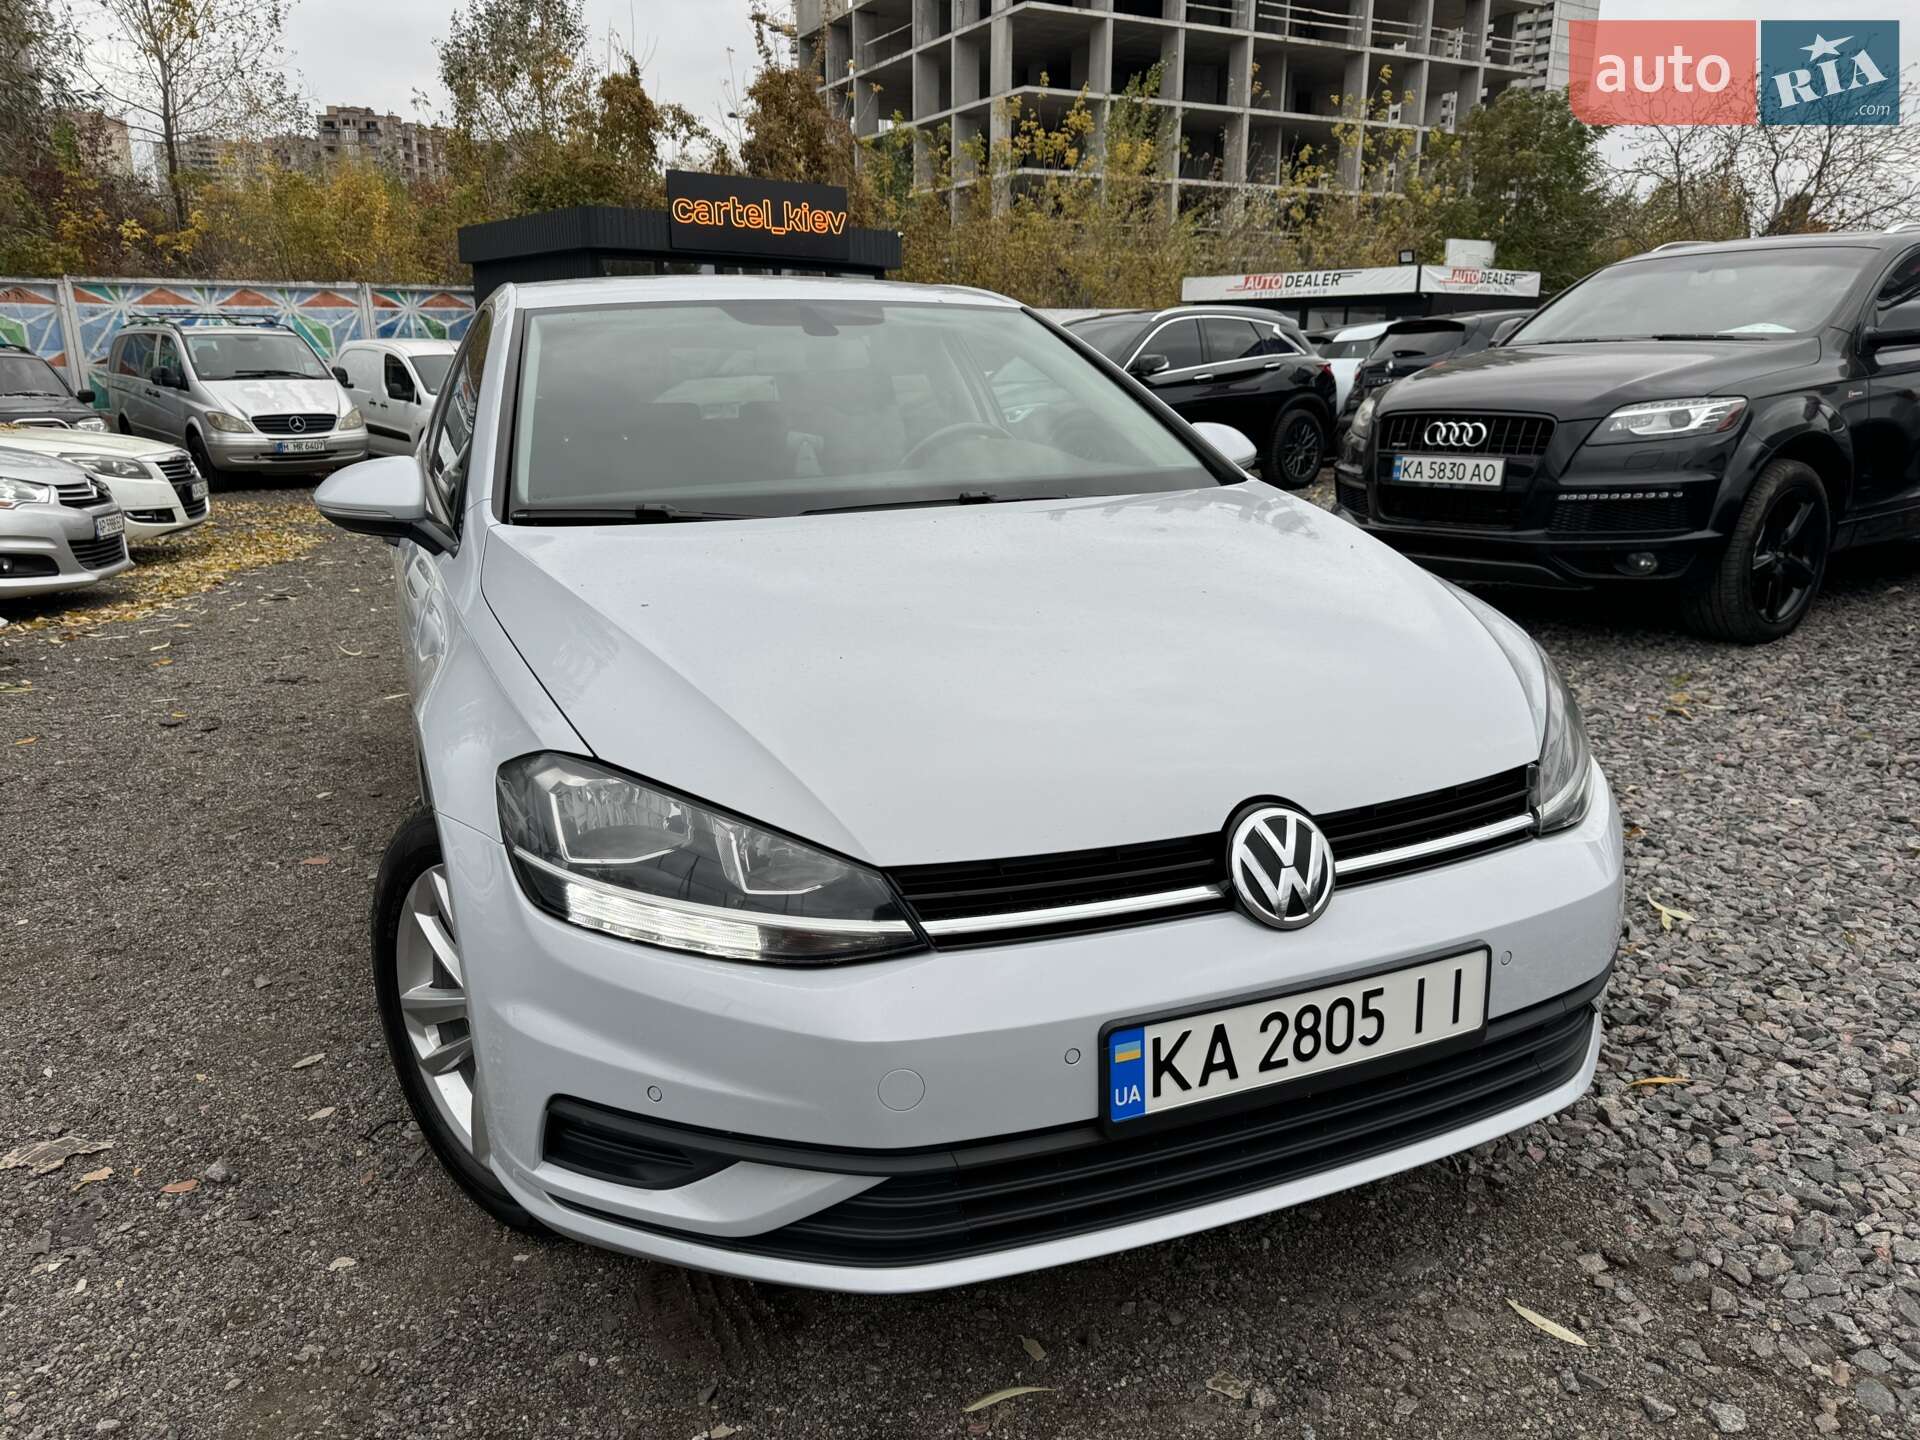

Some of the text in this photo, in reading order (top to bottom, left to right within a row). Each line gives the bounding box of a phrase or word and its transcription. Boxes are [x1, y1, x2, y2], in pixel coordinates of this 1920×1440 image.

[672, 197, 847, 234] cartel_kiev
[1401, 460, 1423, 479] KA
[1428, 461, 1466, 480] 5830
[1470, 463, 1496, 482] AO
[1152, 1023, 1239, 1098] KA
[1258, 987, 1385, 1072] 2805
[1115, 1084, 1141, 1107] UA
